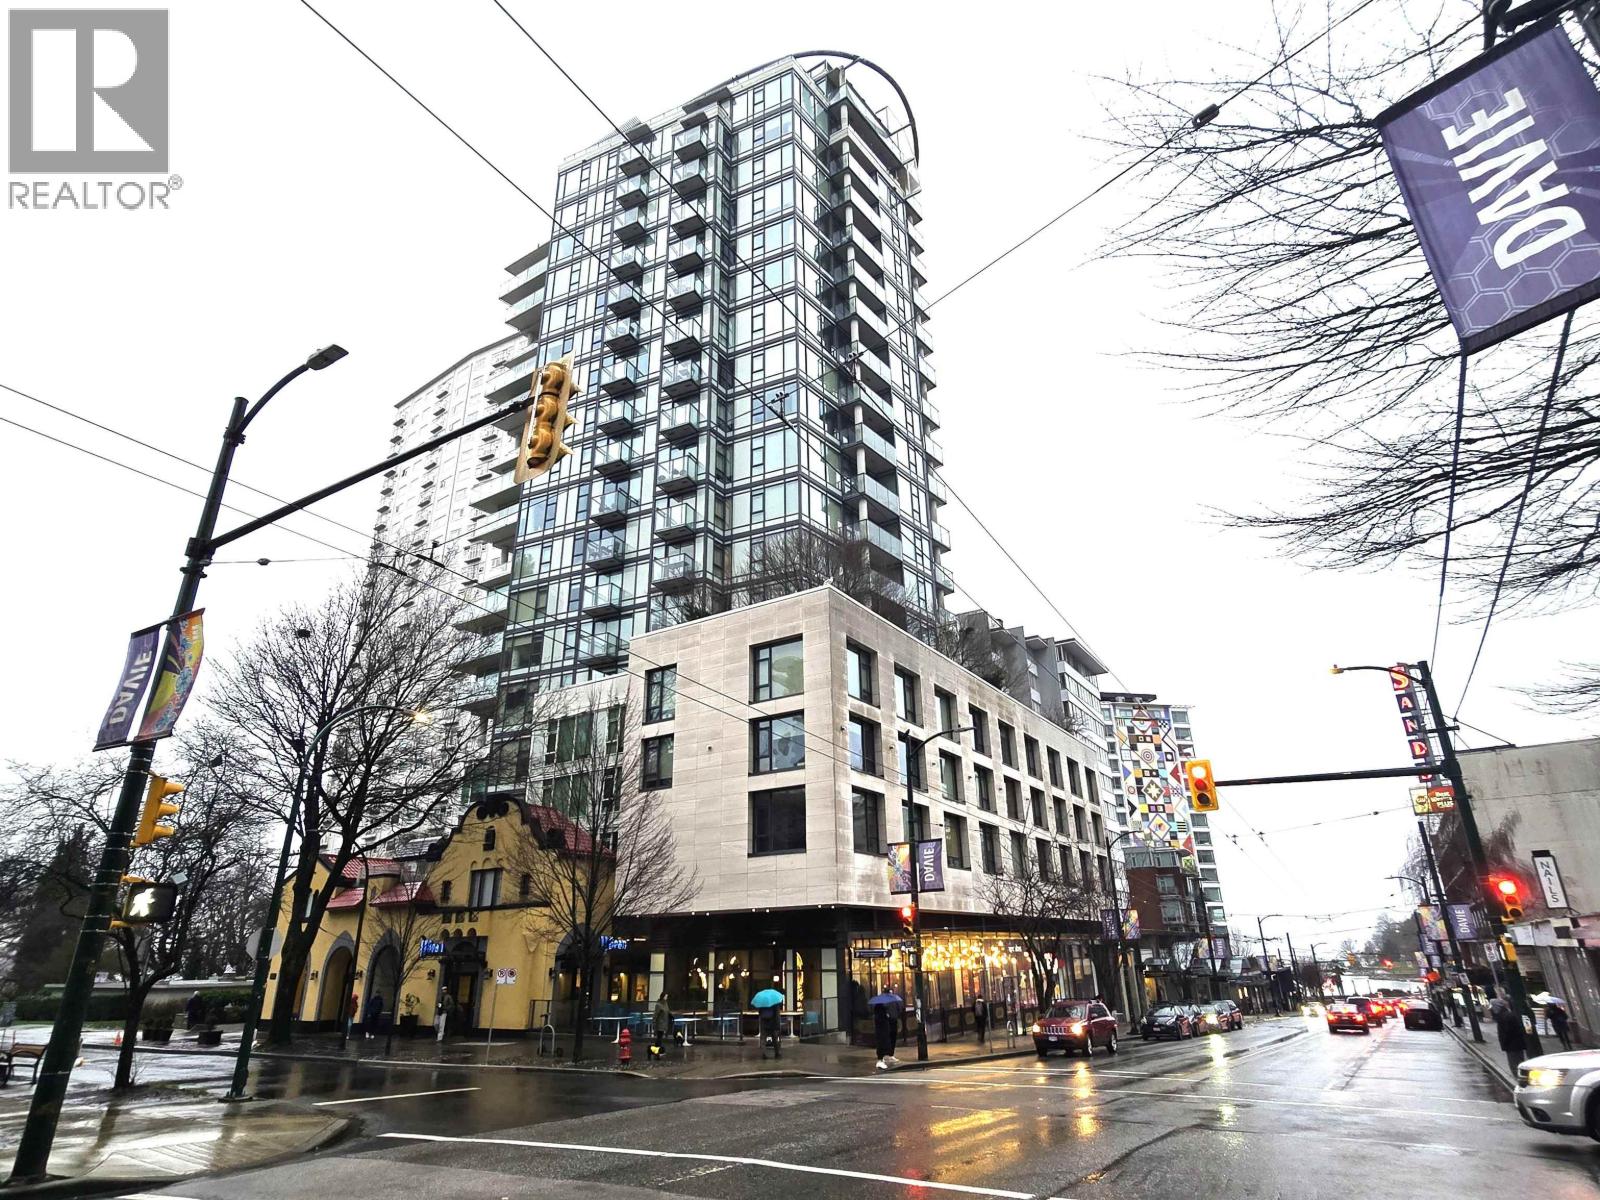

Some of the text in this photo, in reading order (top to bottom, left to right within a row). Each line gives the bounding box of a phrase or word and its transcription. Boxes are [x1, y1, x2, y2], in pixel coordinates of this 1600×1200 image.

[1441, 87, 1586, 270] DAVIE
[108, 650, 152, 725] DAVIE
[923, 847, 935, 882] DAVIE
[1540, 861, 1559, 903] NAILS
[1454, 909, 1470, 933] DAVIE
